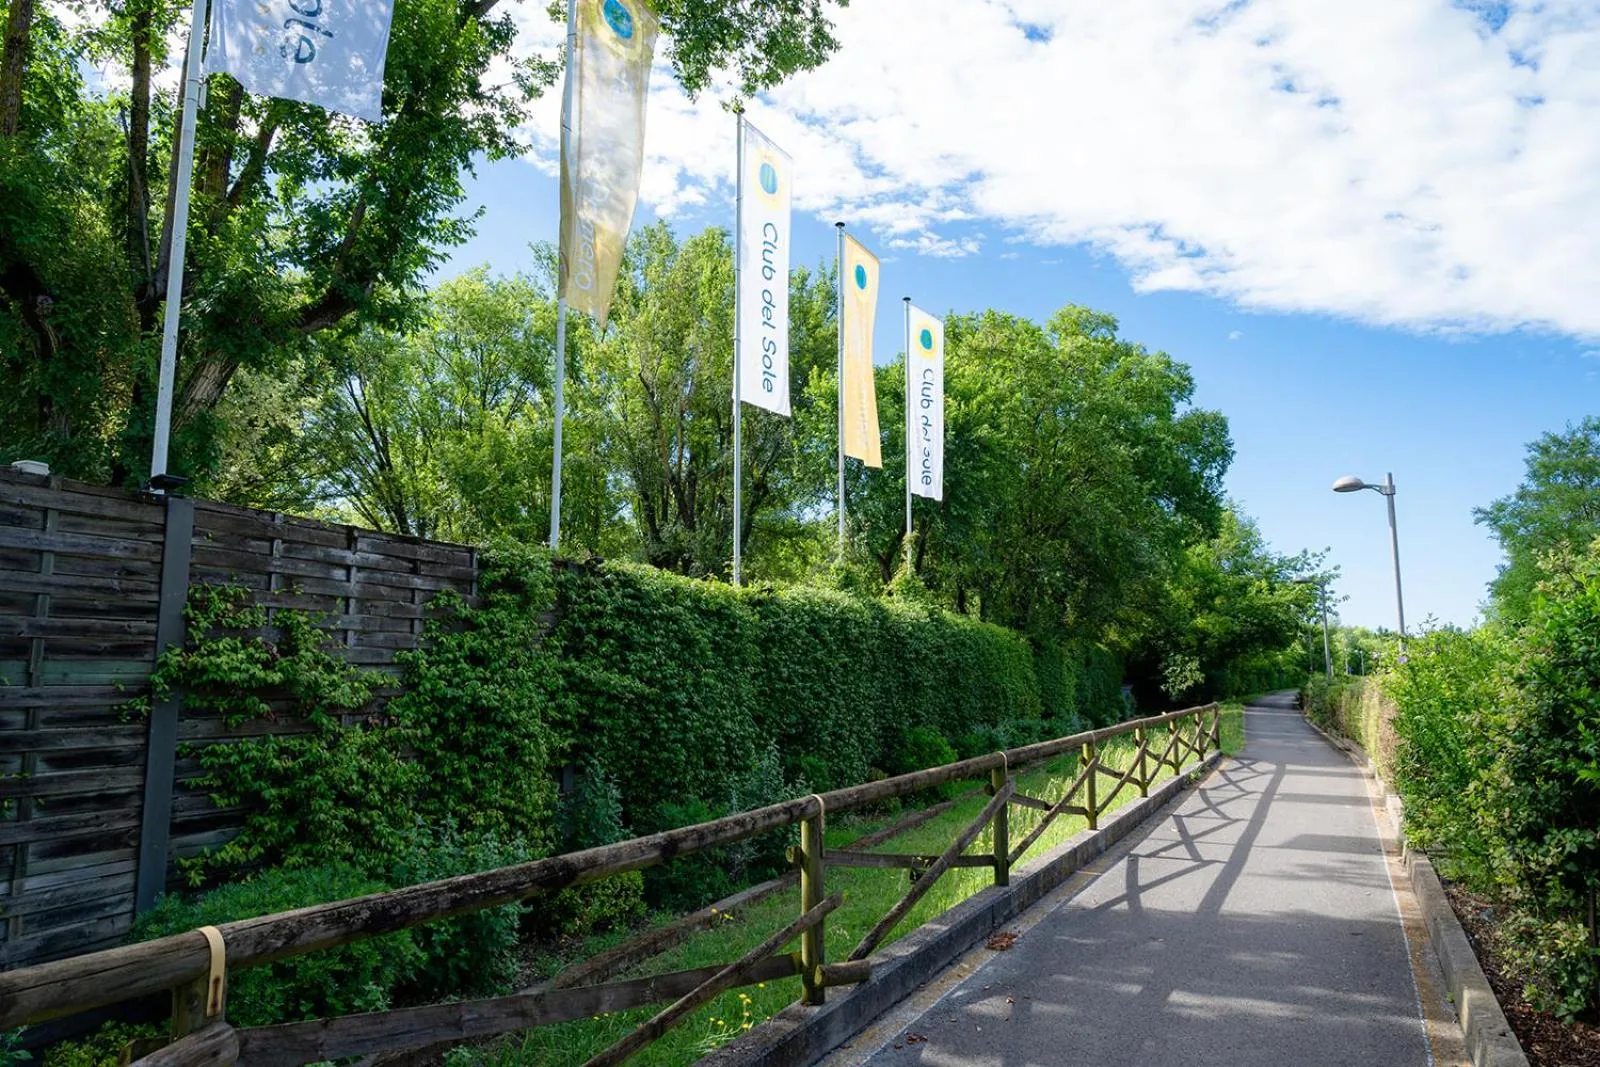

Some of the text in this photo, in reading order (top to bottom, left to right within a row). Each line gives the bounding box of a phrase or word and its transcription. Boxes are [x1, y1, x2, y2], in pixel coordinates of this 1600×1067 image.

[762, 222, 778, 393] Club del Sole
[920, 368, 934, 409] Club
